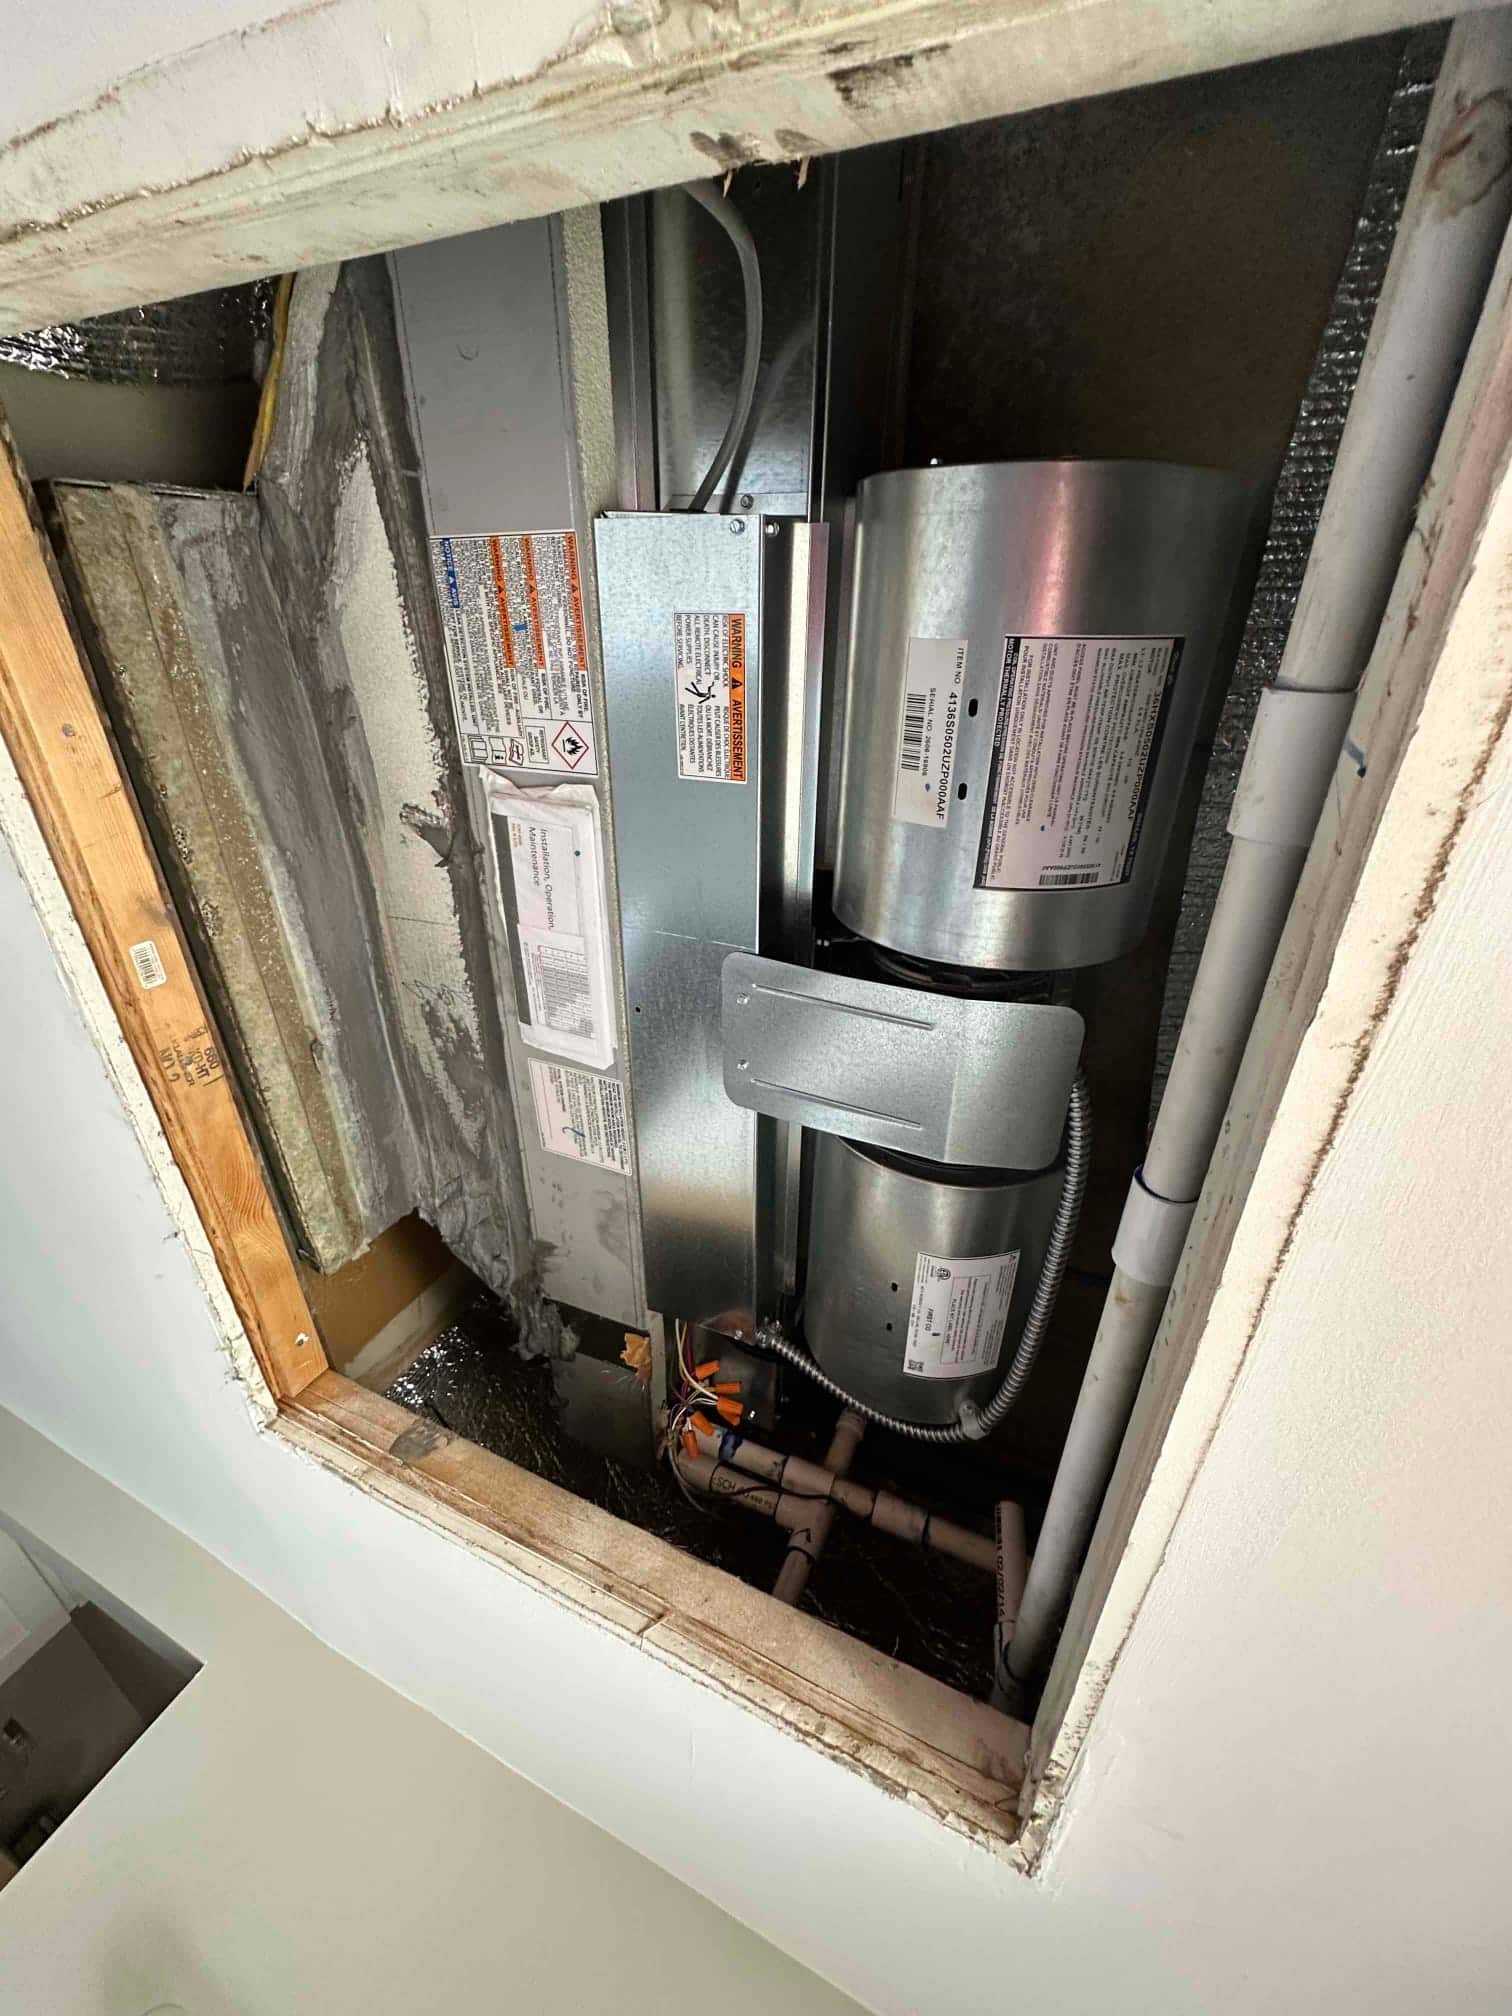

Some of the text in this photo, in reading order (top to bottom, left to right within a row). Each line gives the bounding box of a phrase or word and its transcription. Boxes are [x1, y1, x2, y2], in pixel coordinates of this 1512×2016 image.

[444, 541, 453, 571] NOTICE
[493, 539, 502, 581] WARNING
[500, 598, 513, 666] AVERTISSEMENT
[524, 538, 534, 581] WARNING
[531, 598, 543, 667] AVERTISSEMENT
[567, 536, 577, 580] WARNING
[573, 597, 585, 669] AVERTISSEMENT
[714, 672, 719, 680] OR
[956, 648, 964, 669] ITEM
[732, 619, 742, 778] WARNING AVERTISSEMENT
[927, 688, 936, 717] SERIAL
[995, 639, 1014, 747] MOTOR THERMALLY PROTECTED
[1016, 665, 1026, 705] INSTALLATION
[1021, 670, 1031, 709] INSTALLATION
[706, 705, 712, 713] OU
[1013, 736, 1021, 762] LOCATION
[524, 826, 545, 887] Maintenance
[536, 829, 555, 882] Installation,
